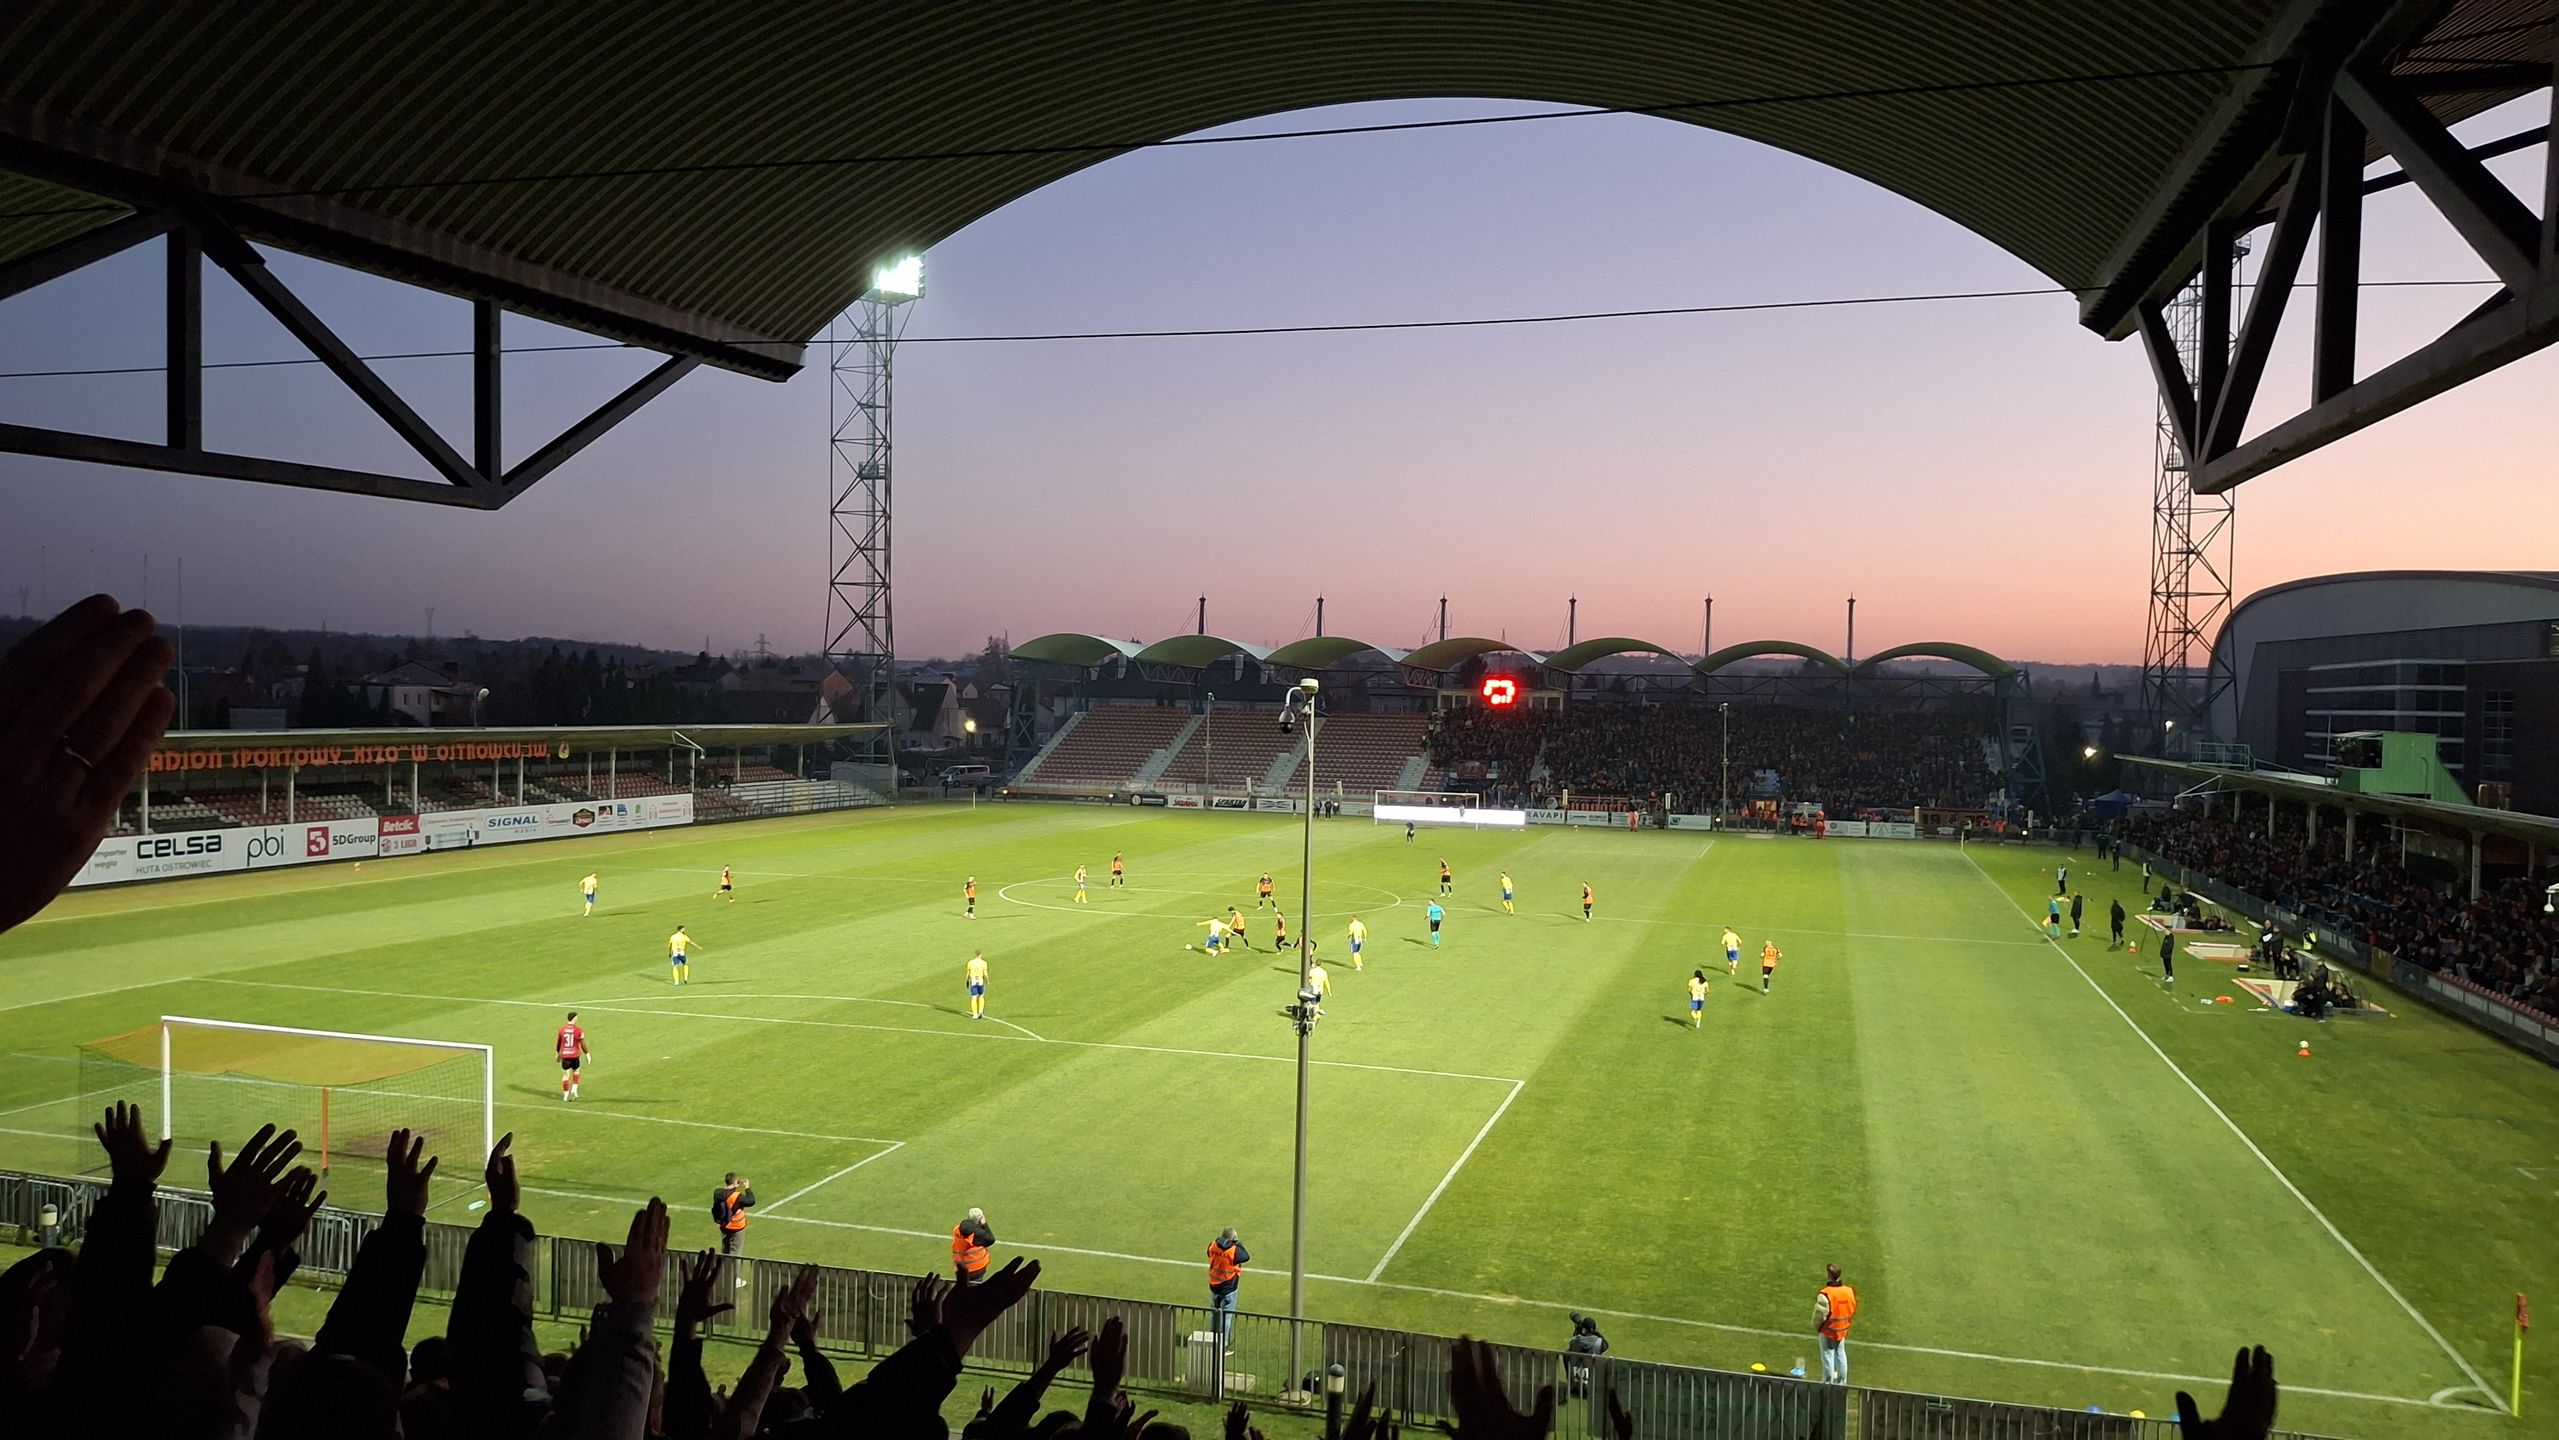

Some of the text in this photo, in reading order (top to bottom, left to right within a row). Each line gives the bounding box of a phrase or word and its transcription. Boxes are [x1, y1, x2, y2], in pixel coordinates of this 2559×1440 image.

[232, 746, 342, 768] SPORTOWY
[411, 744, 428, 762] W
[436, 742, 523, 761] OSTROWCU
[488, 815, 538, 827] SIGNAL
[332, 834, 376, 846] 5DGroup
[246, 828, 285, 867] pbi
[136, 860, 212, 875] HUTA OSTROWIEC
[564, 1033, 575, 1047] 31
